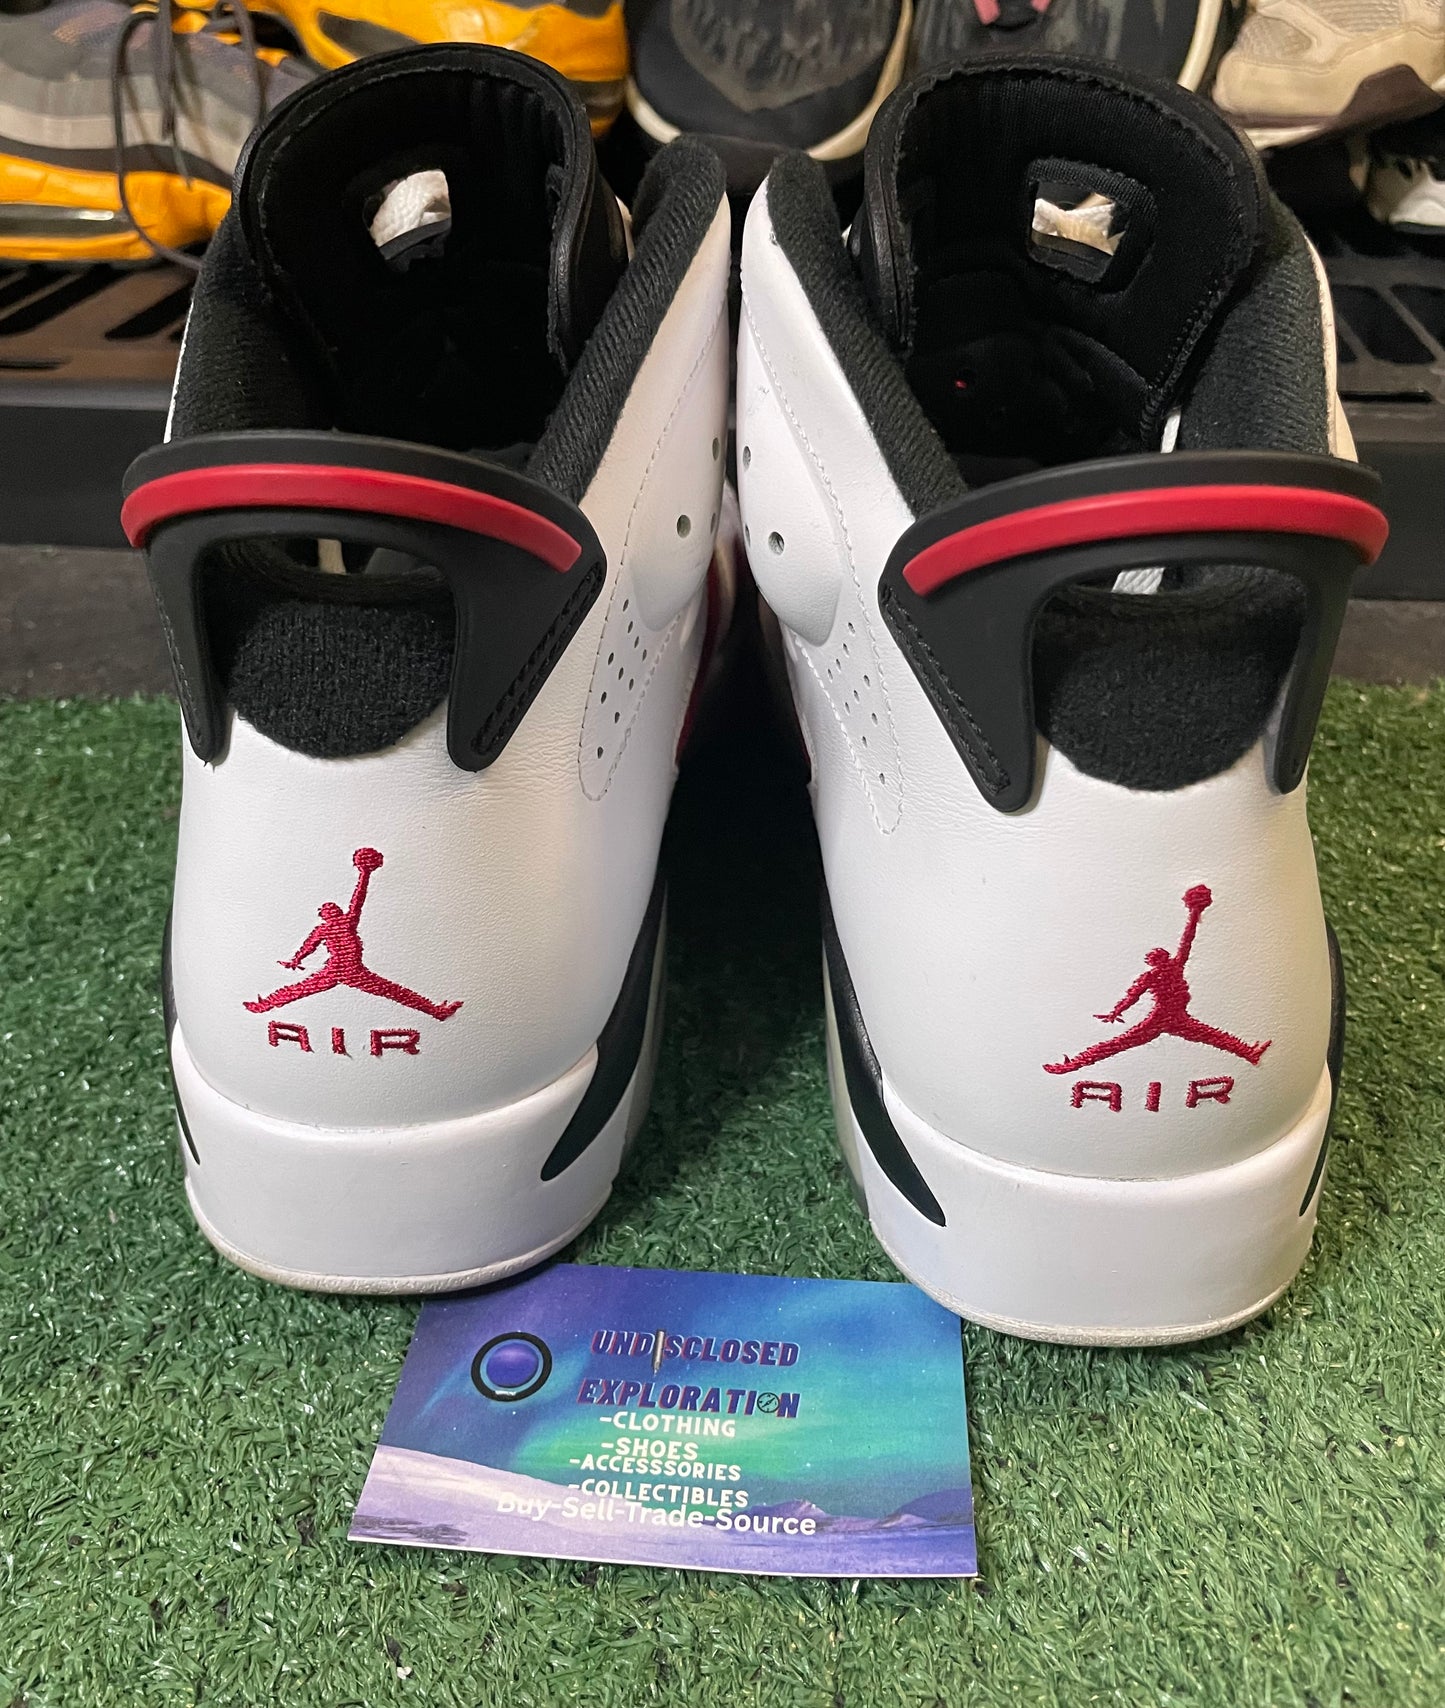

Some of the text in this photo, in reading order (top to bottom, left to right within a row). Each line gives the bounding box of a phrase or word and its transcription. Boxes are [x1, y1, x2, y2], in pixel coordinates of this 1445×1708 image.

[268, 1021, 420, 1056] AIR
[1071, 1076, 1234, 1112] AIR
[600, 1411, 736, 1438] -CLOTHING
[601, 1437, 699, 1461] -SHOES
[569, 1454, 742, 1481] -ACCESSSORIES
[568, 1478, 749, 1508] -COLLECTIBLES
[497, 1491, 816, 1535] Buy-Sell-Trade-Source
